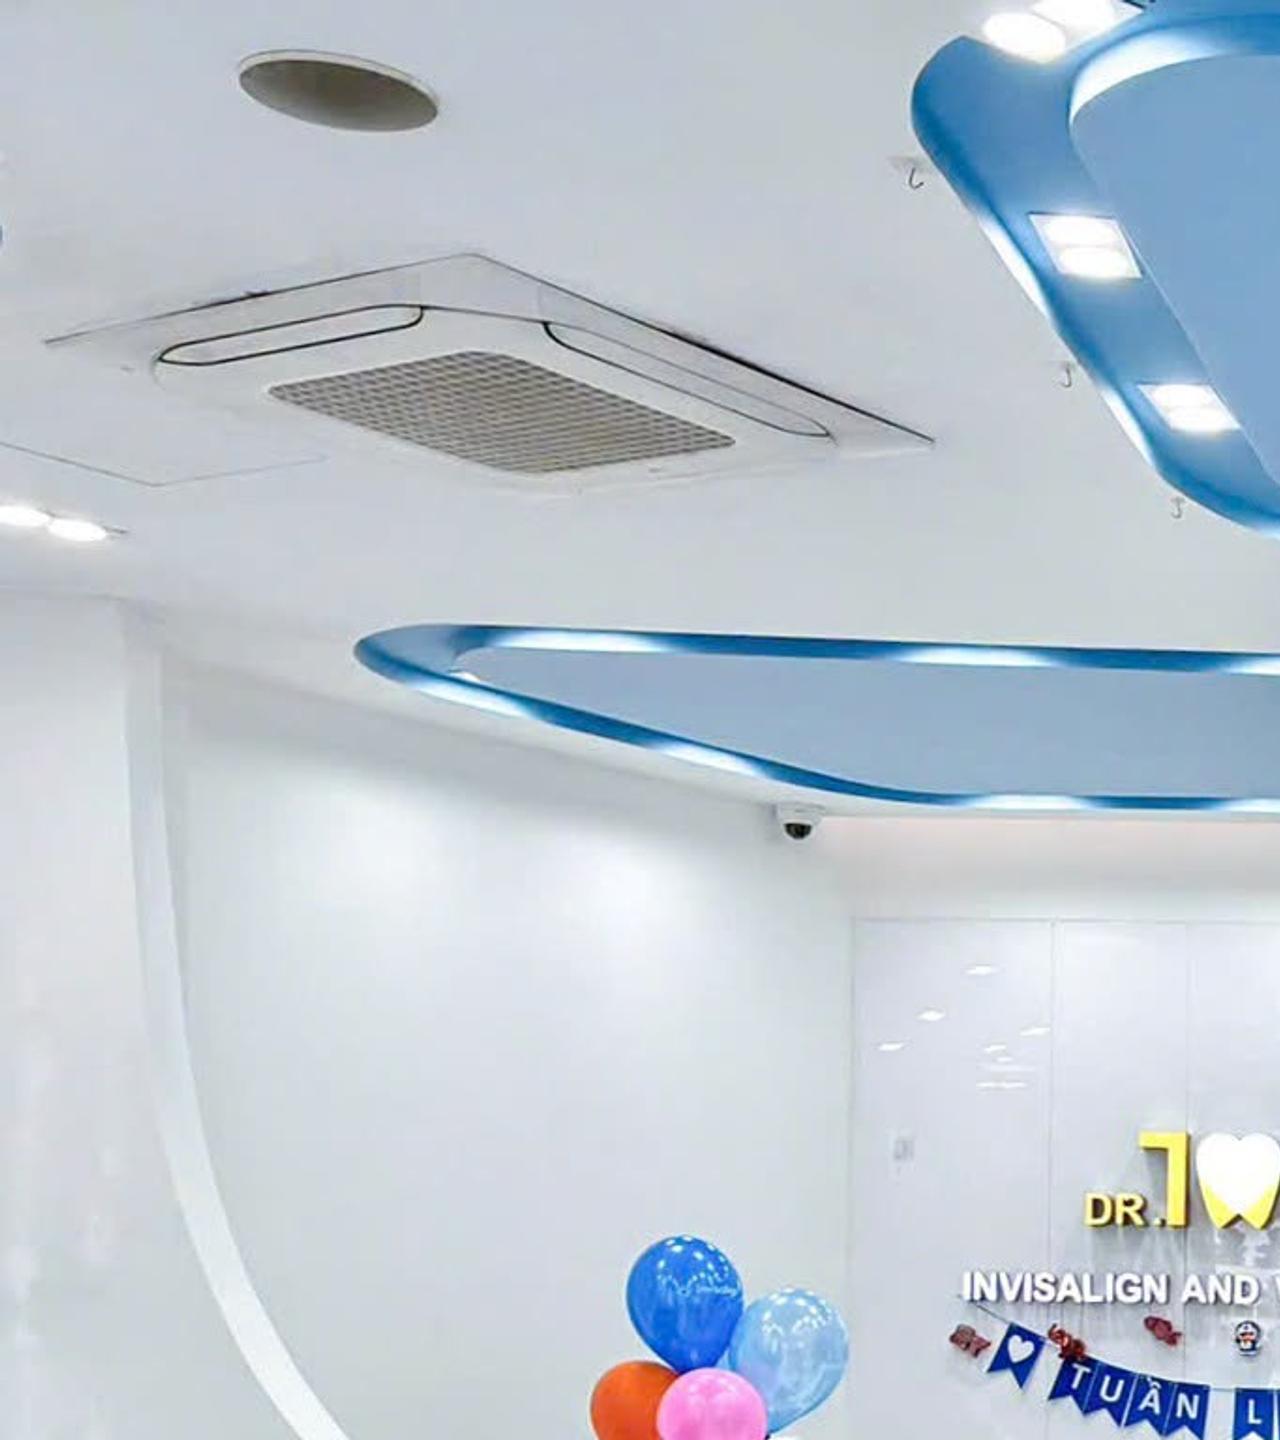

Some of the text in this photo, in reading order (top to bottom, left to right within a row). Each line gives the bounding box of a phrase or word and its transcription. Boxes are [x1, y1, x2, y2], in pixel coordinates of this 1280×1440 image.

[962, 1270, 1169, 1305] INVISALIGN
[1181, 1275, 1260, 1305] AND
[1070, 1363, 1202, 1421] TUẦN
